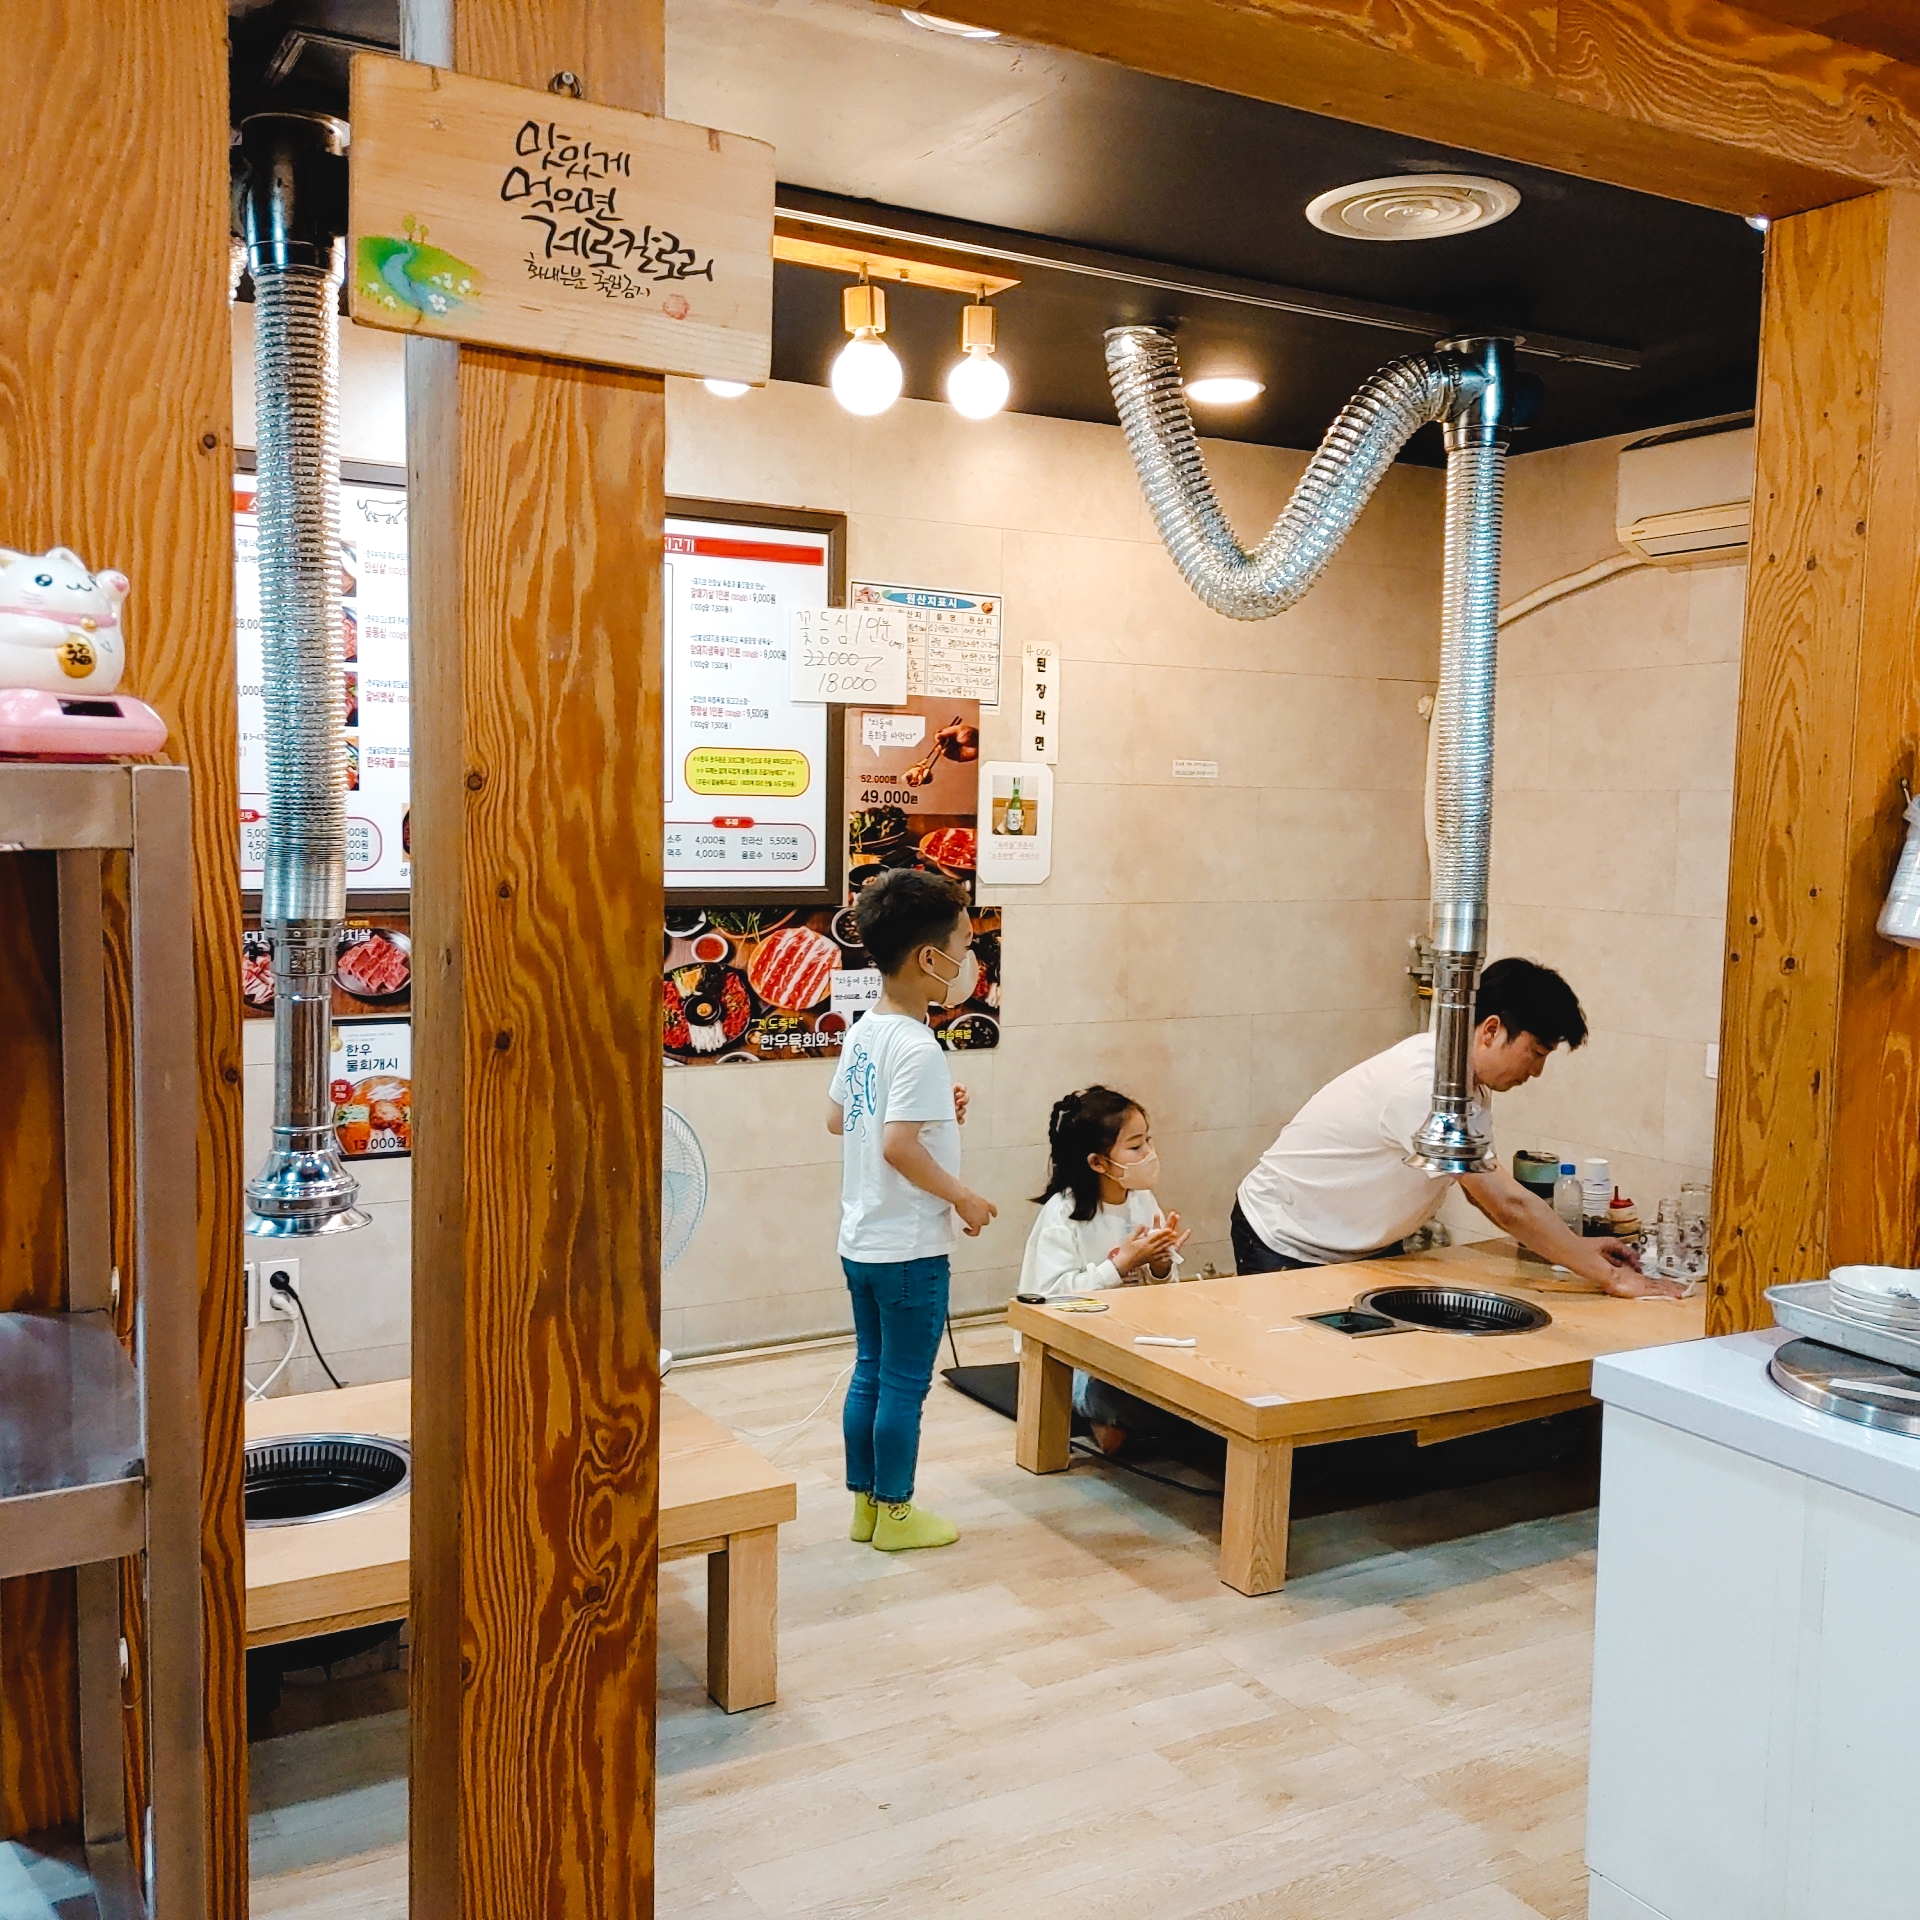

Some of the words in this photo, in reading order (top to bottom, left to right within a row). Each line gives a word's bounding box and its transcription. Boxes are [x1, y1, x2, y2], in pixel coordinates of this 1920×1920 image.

[516, 120, 631, 181] 맛있게
[500, 166, 624, 221] 먹으면
[521, 215, 714, 282] 제로칼로리
[905, 594, 958, 609] 원산지표시
[365, 627, 387, 639] 꽃등심
[763, 649, 787, 661] 9,000원
[803, 648, 859, 666] 22000
[818, 672, 877, 693] 18000
[861, 790, 918, 804] 49.000원
[667, 834, 682, 844] 소주
[695, 836, 726, 845] 4,000원
[741, 836, 763, 845] 한라산
[769, 837, 798, 846] 5,500원
[667, 849, 682, 858] 맥주
[695, 850, 726, 859] 4,000원
[771, 852, 798, 860] 1,500원
[346, 1043, 373, 1057] 한우
[346, 1058, 398, 1073] 물회개시
[354, 1136, 407, 1150] 13.000원
